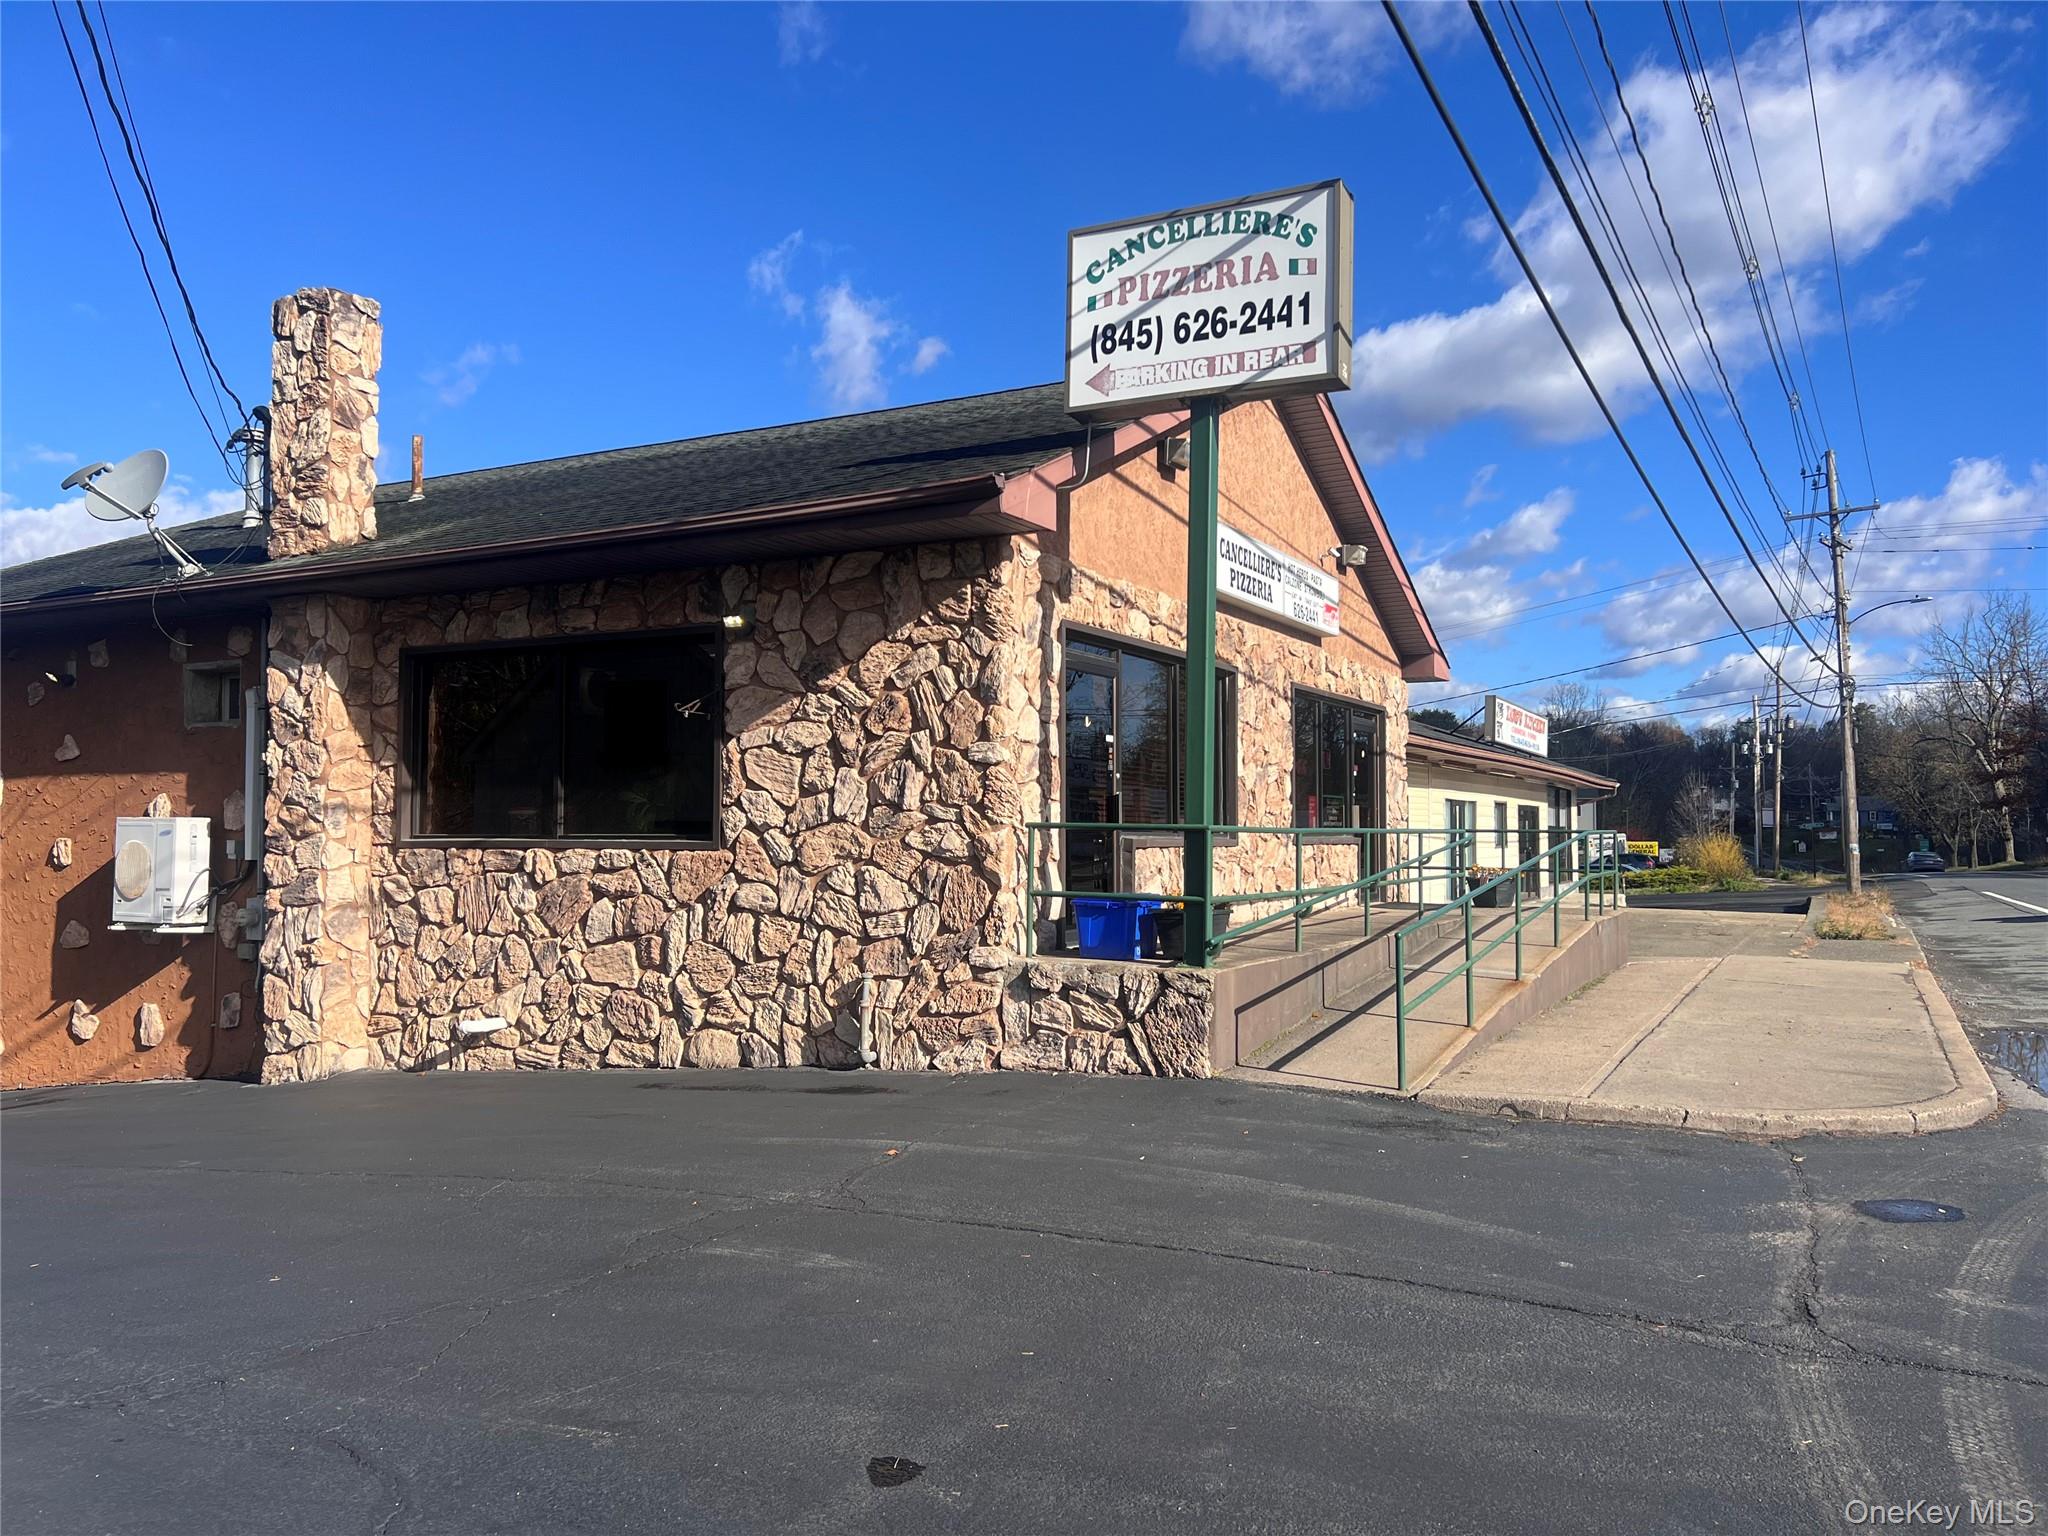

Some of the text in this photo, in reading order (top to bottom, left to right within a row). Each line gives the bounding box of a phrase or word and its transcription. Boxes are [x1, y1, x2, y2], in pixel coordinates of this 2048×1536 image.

[1086, 211, 1318, 284] CANCELLIERE'S
[1117, 252, 1280, 306] PIZZERIA
[1091, 291, 1311, 363] (845) 626-2441
[1115, 344, 1304, 390] PARKING IN REAR
[1220, 538, 1282, 583] CANCELLIERE'S
[1230, 568, 1273, 603] PIZZERIA
[1293, 602, 1319, 625] 626-2441
